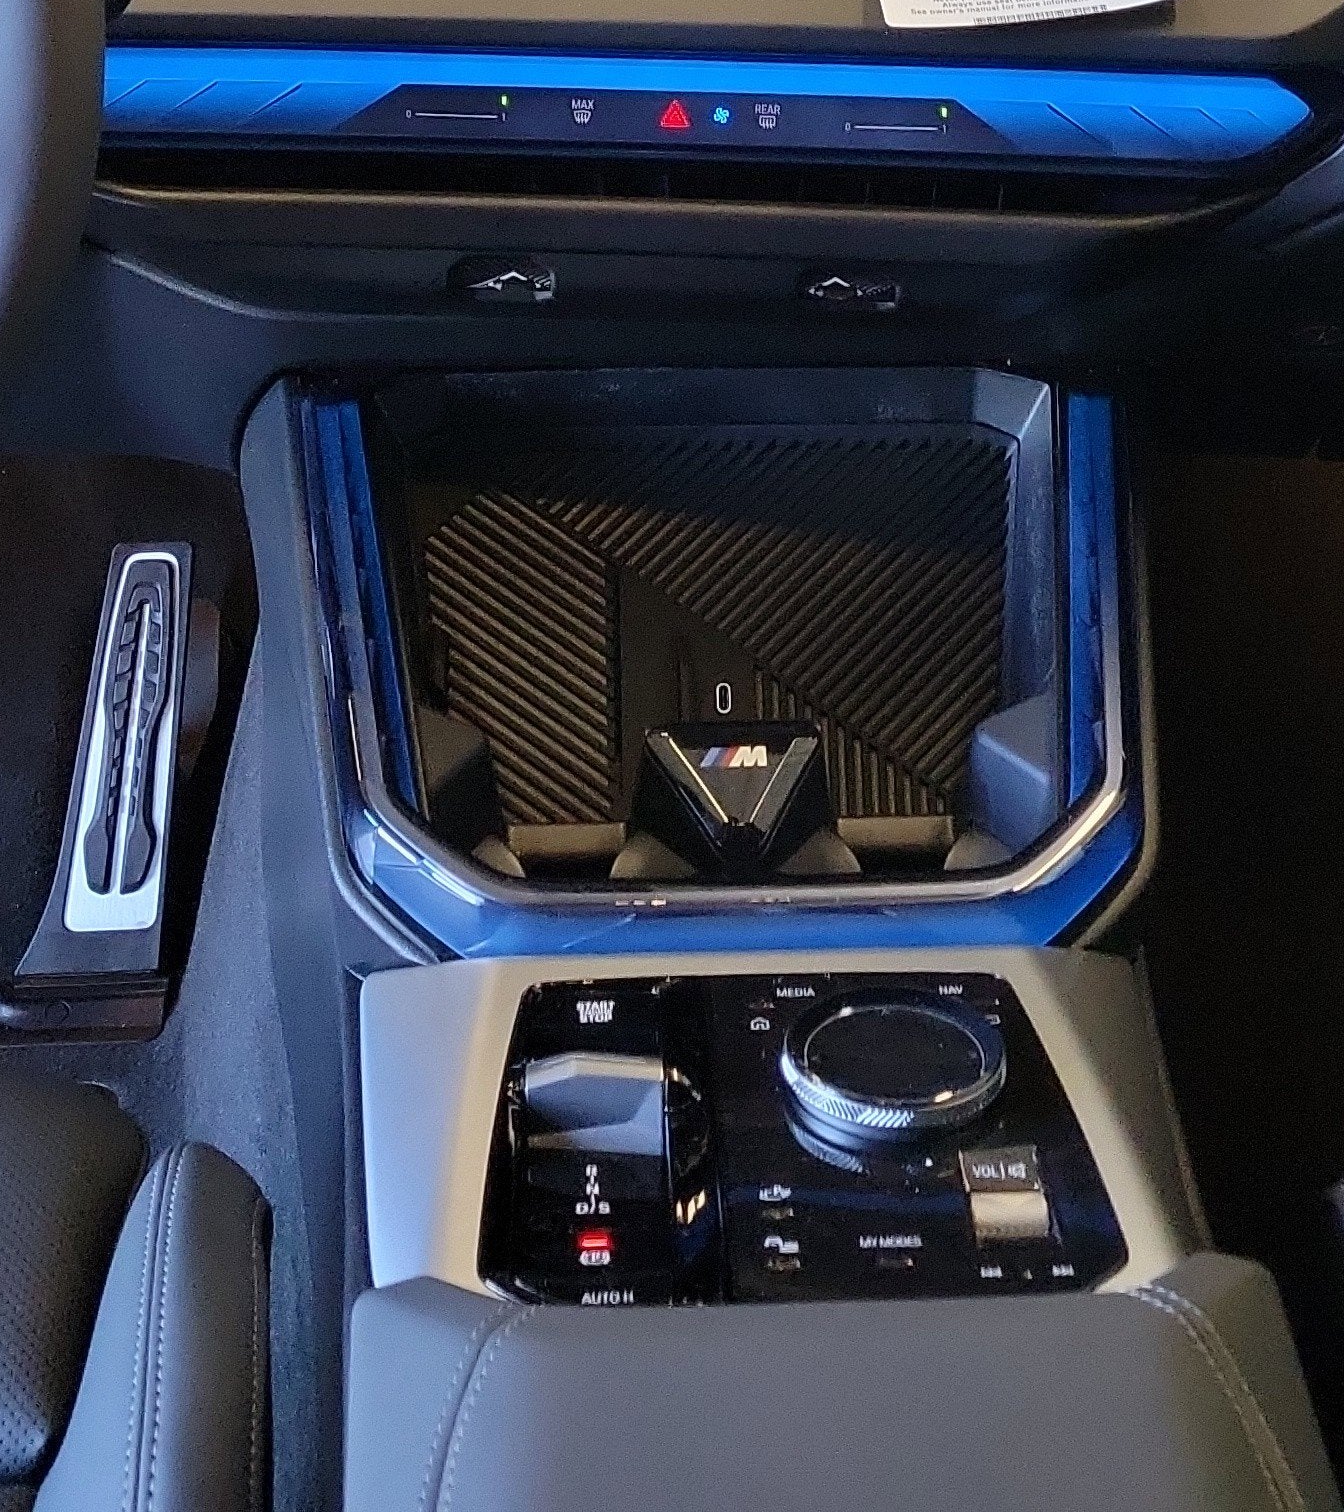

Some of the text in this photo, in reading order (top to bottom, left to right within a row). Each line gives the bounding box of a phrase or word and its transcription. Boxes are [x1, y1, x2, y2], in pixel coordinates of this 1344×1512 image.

[571, 99, 595, 110] MAX
[755, 104, 781, 115] REAR
[776, 987, 815, 998] MEDIA
[939, 985, 963, 996] NAV
[972, 1164, 999, 1179] VOL
[581, 1290, 634, 1305] AUTO H
